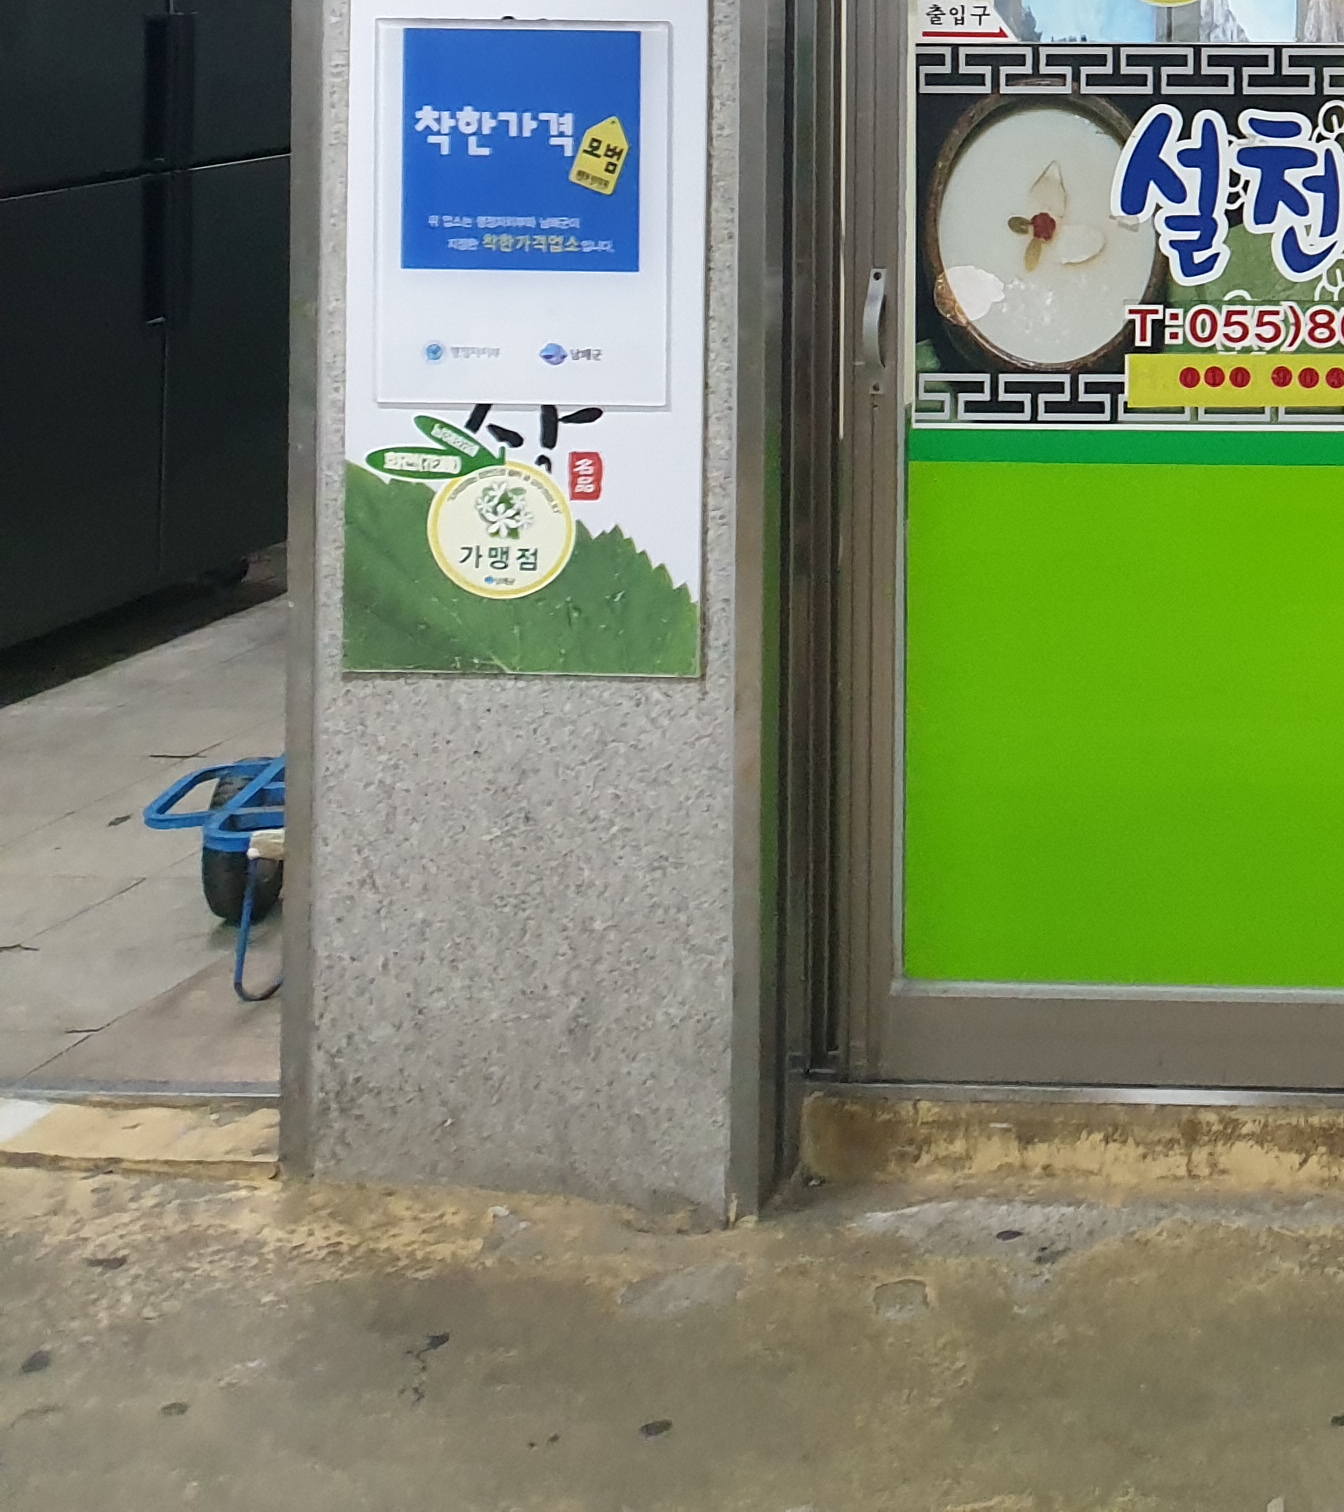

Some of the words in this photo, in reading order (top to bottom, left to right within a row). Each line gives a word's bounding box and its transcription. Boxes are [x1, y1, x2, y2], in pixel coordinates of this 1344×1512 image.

[925, 3, 991, 27] 출입구
[414, 105, 576, 158] 착한가격
[582, 137, 624, 175] 모범
[459, 545, 539, 572] 가맹점
